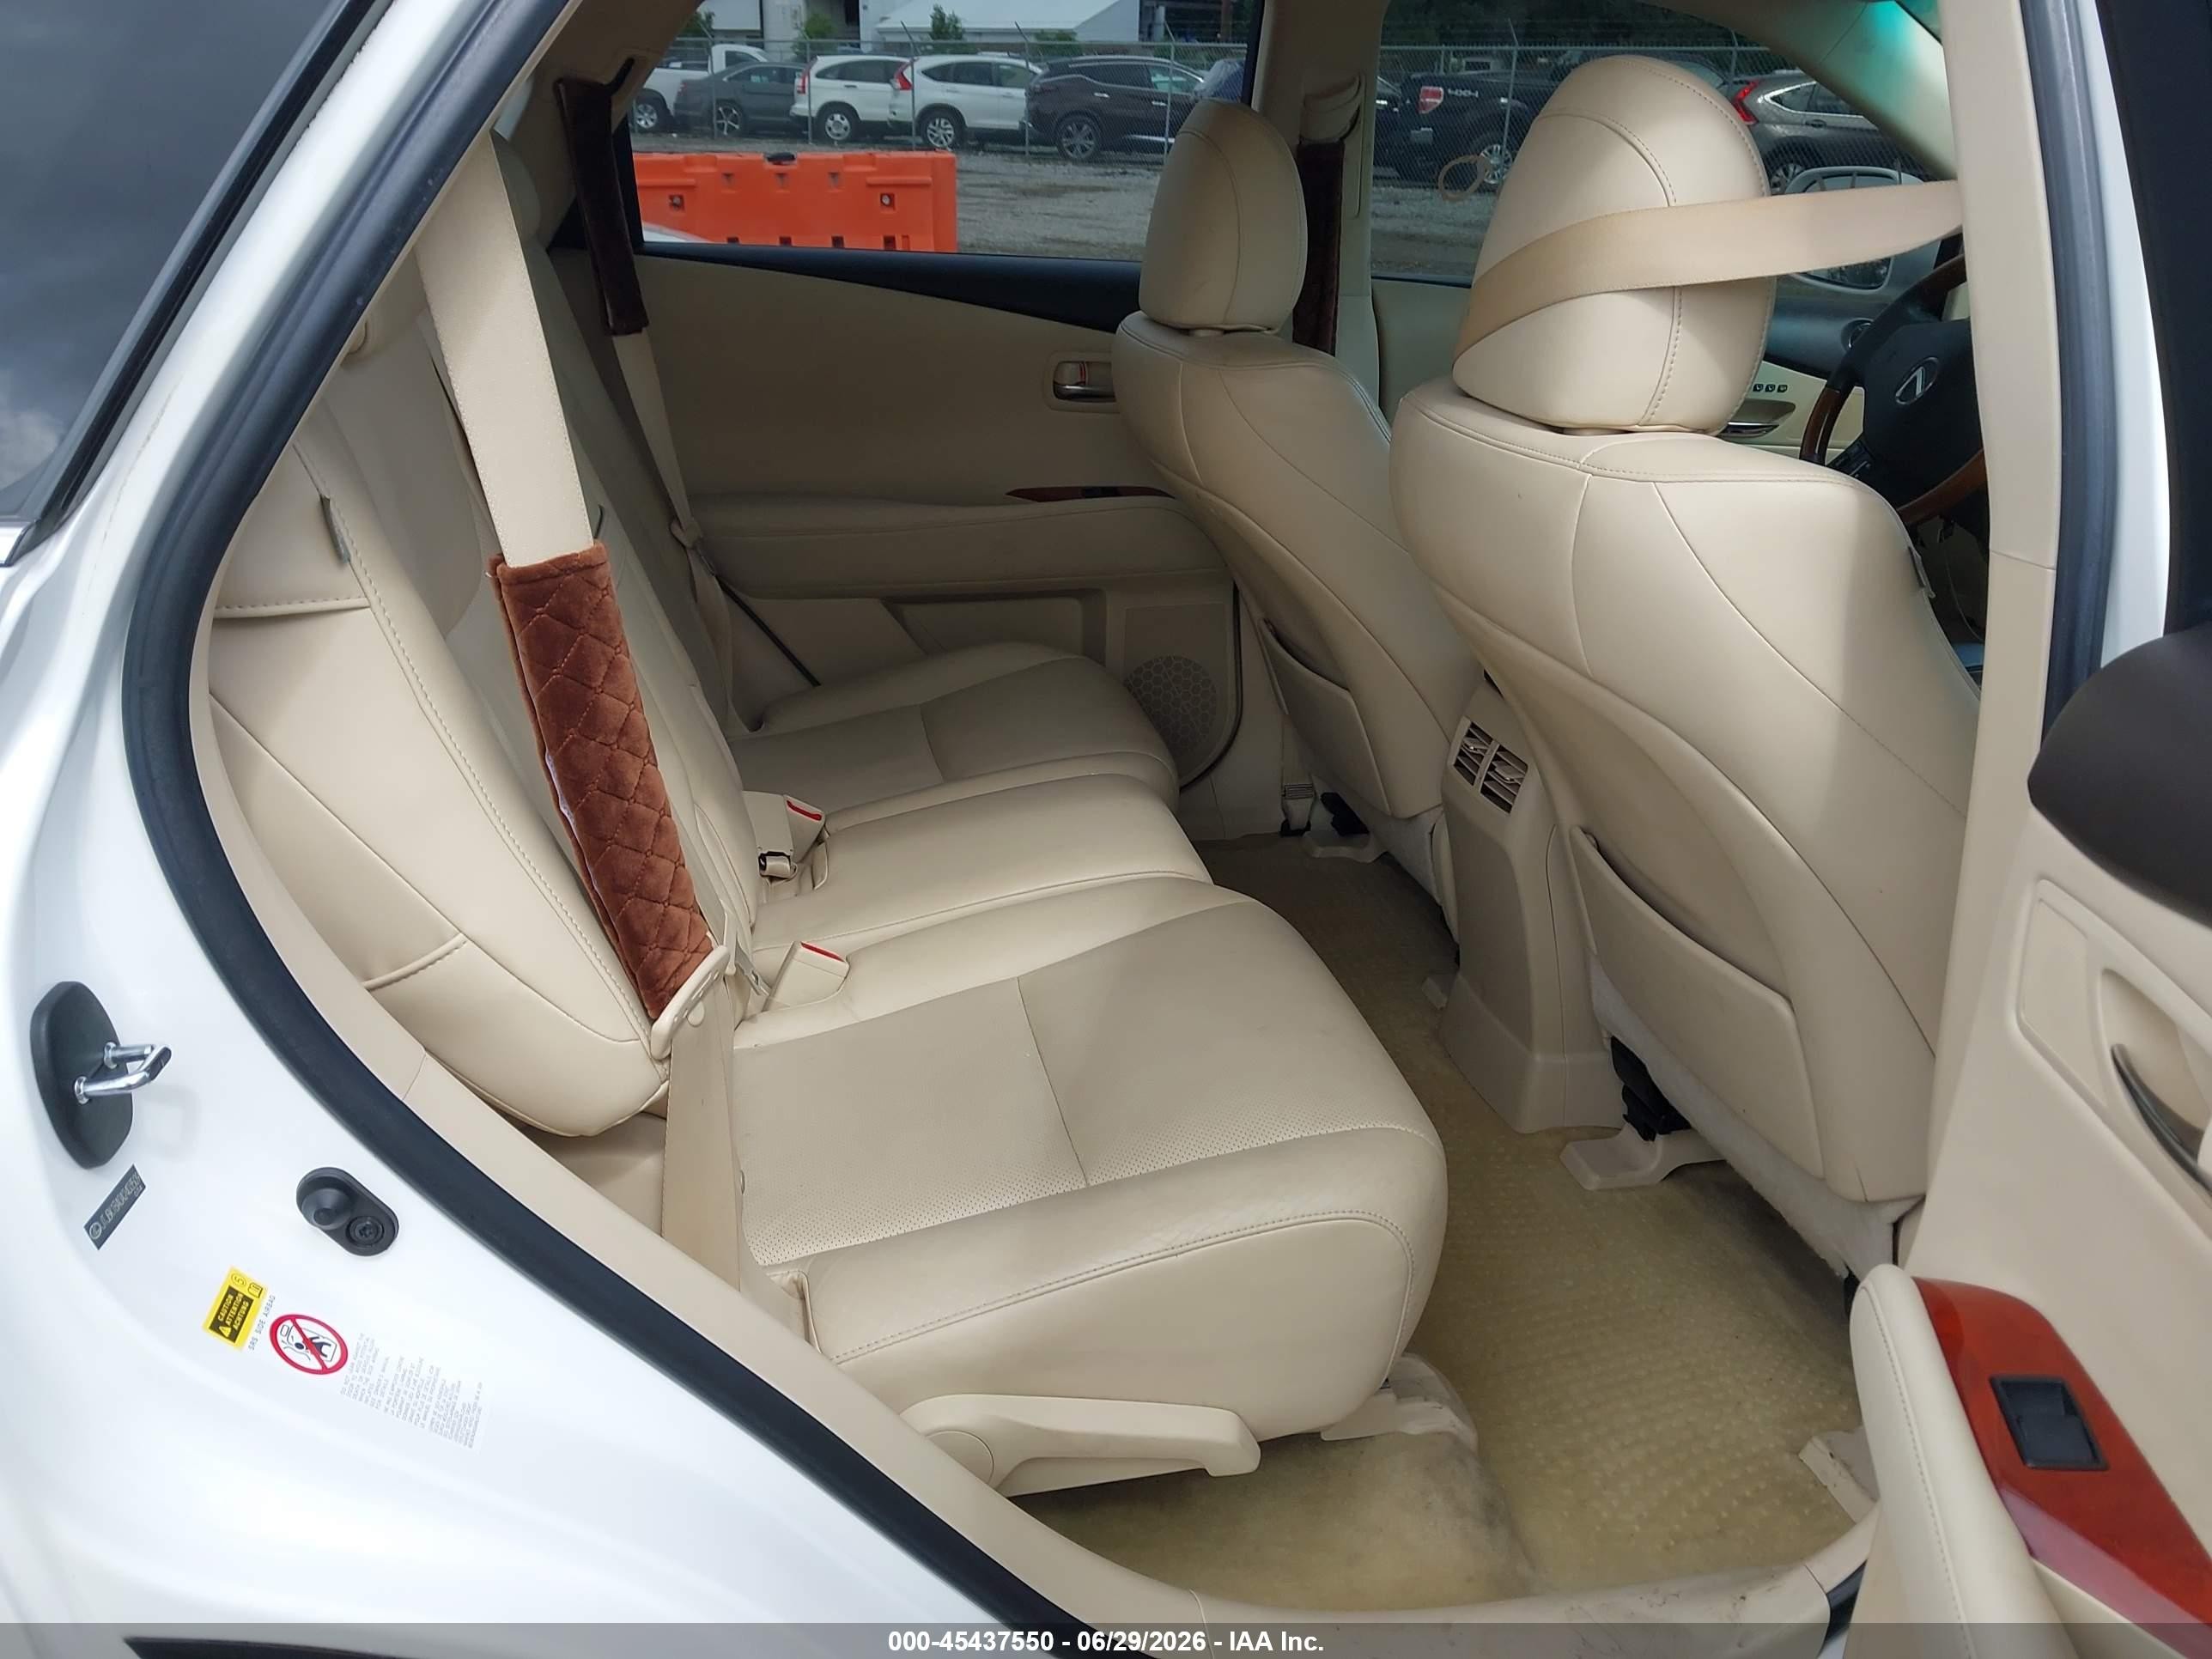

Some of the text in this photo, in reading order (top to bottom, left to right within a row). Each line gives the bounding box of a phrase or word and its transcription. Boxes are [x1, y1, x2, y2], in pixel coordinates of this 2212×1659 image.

[217, 1294, 234, 1322] CAUTION
[225, 1291, 244, 1326] ATTENTION
[233, 1301, 249, 1330] ACHTUNG
[248, 1294, 276, 1351] SRS SIDE AIRBAG
